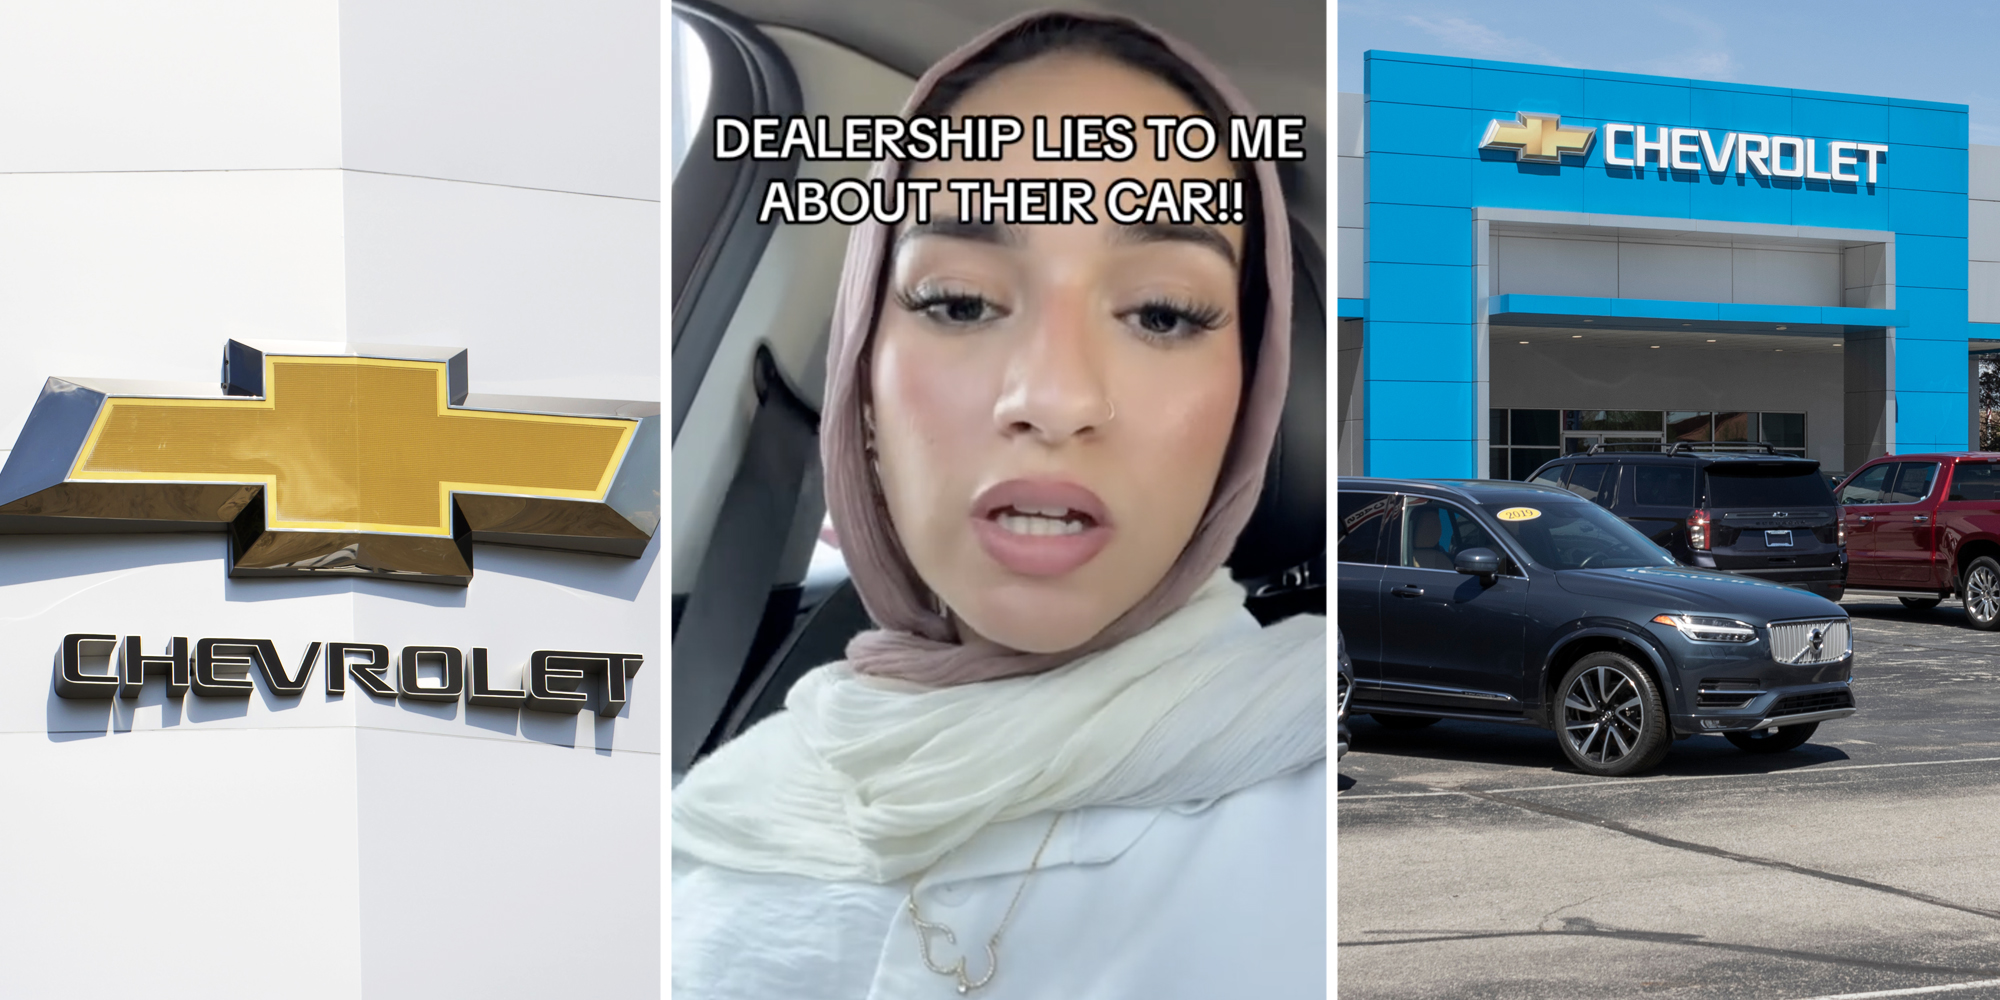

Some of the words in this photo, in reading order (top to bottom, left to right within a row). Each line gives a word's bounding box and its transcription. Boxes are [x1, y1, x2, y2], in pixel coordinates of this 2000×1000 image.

[1604, 123, 1888, 183] CHEVROLET
[1505, 508, 1534, 520] 2019
[57, 633, 643, 714] CHEVROLET
